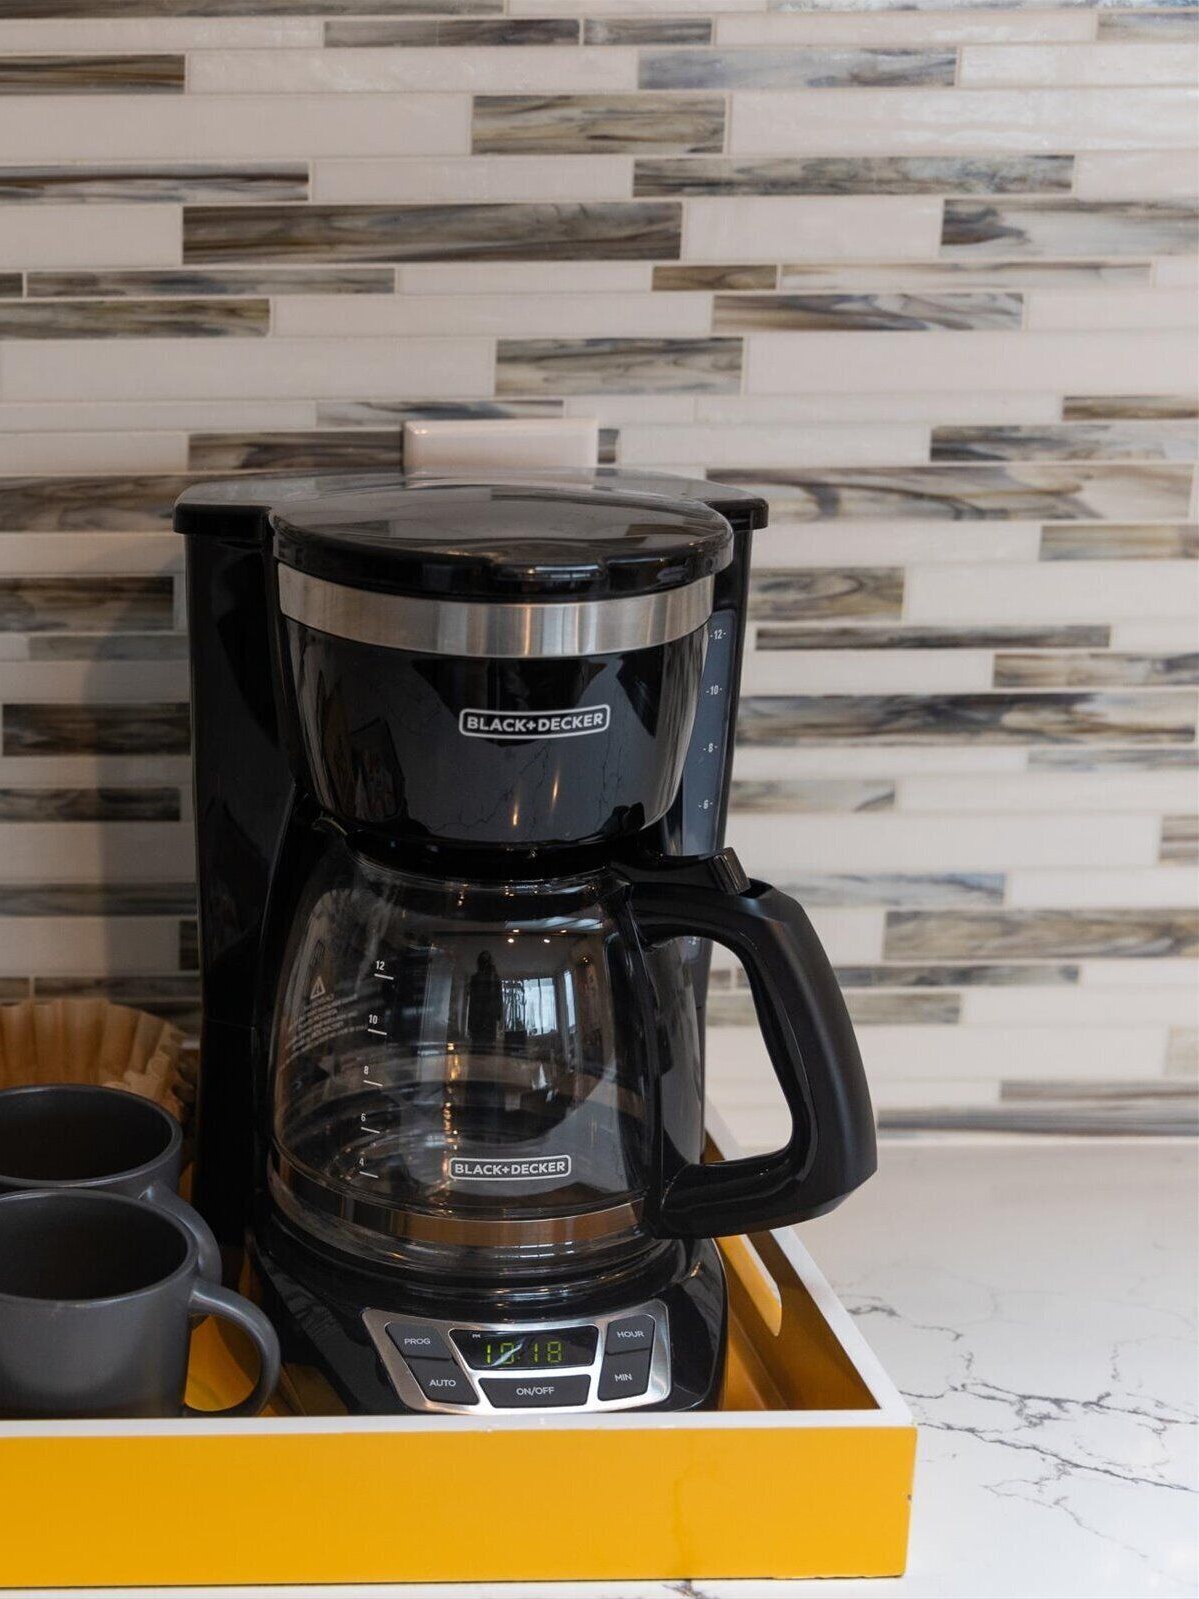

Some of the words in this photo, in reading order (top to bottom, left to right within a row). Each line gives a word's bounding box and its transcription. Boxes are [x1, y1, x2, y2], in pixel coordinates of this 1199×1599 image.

[466, 712, 604, 732] BLACK+DECKER
[375, 960, 385, 971] 12
[368, 1014, 378, 1025] 10
[363, 1065, 369, 1075] 8
[360, 1113, 367, 1122] 6
[454, 1161, 566, 1175] BLACK+DECKER
[616, 1330, 645, 1338] HOUR
[404, 1337, 431, 1345] PROG
[429, 1378, 457, 1387] AUTO
[614, 1373, 632, 1382] MIN
[516, 1386, 555, 1396] ON/OFF
